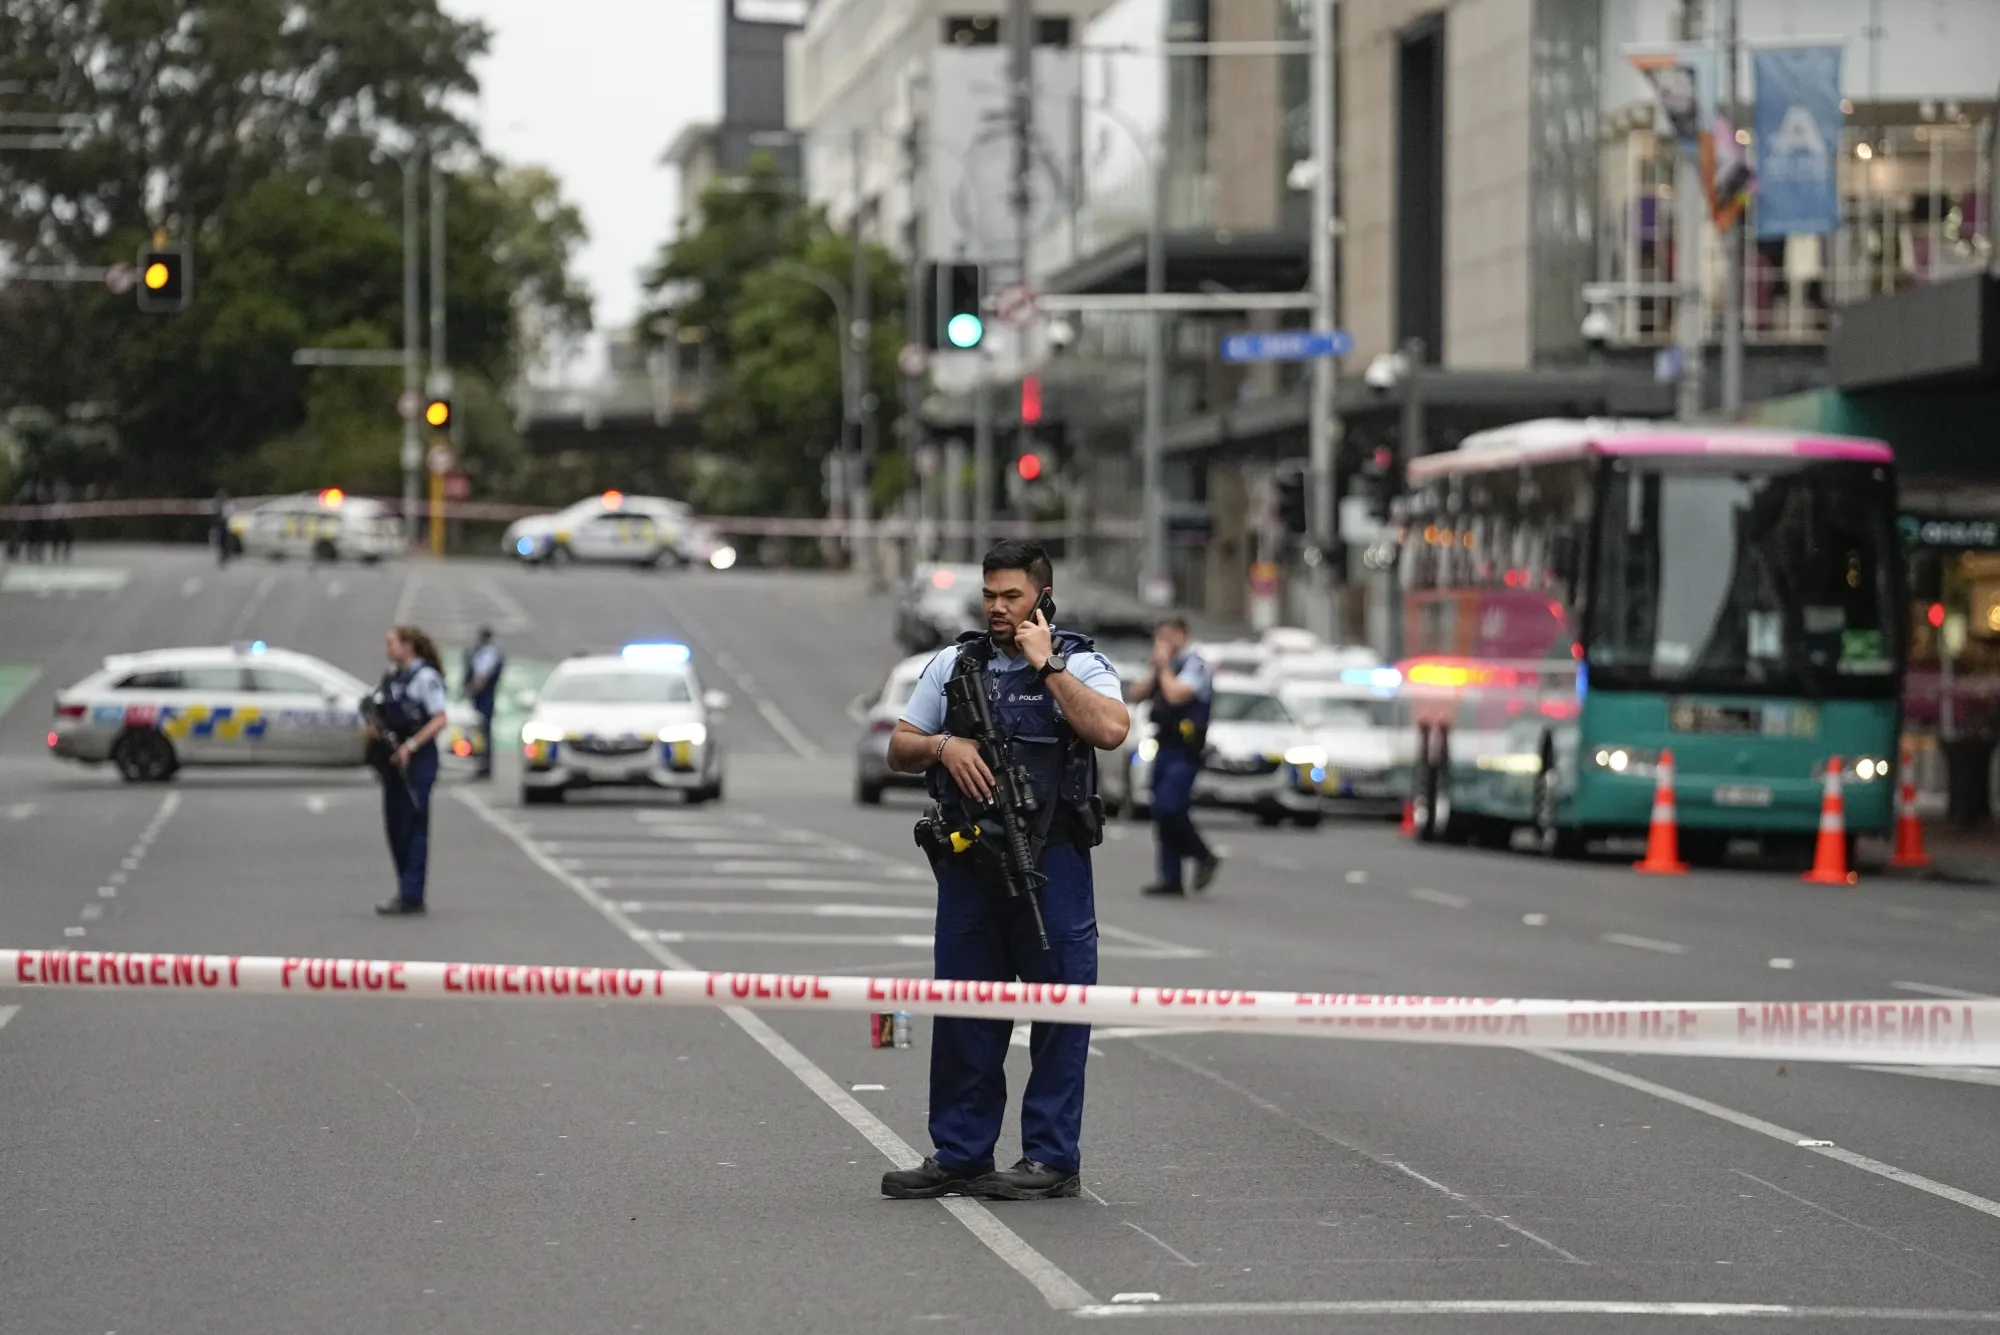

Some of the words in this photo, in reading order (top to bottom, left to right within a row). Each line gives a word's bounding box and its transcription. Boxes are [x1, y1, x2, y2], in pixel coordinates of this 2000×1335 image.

[16, 951, 241, 988] EMERGENCY
[281, 957, 407, 991] POLICE
[444, 963, 664, 997] EMERGENCY
